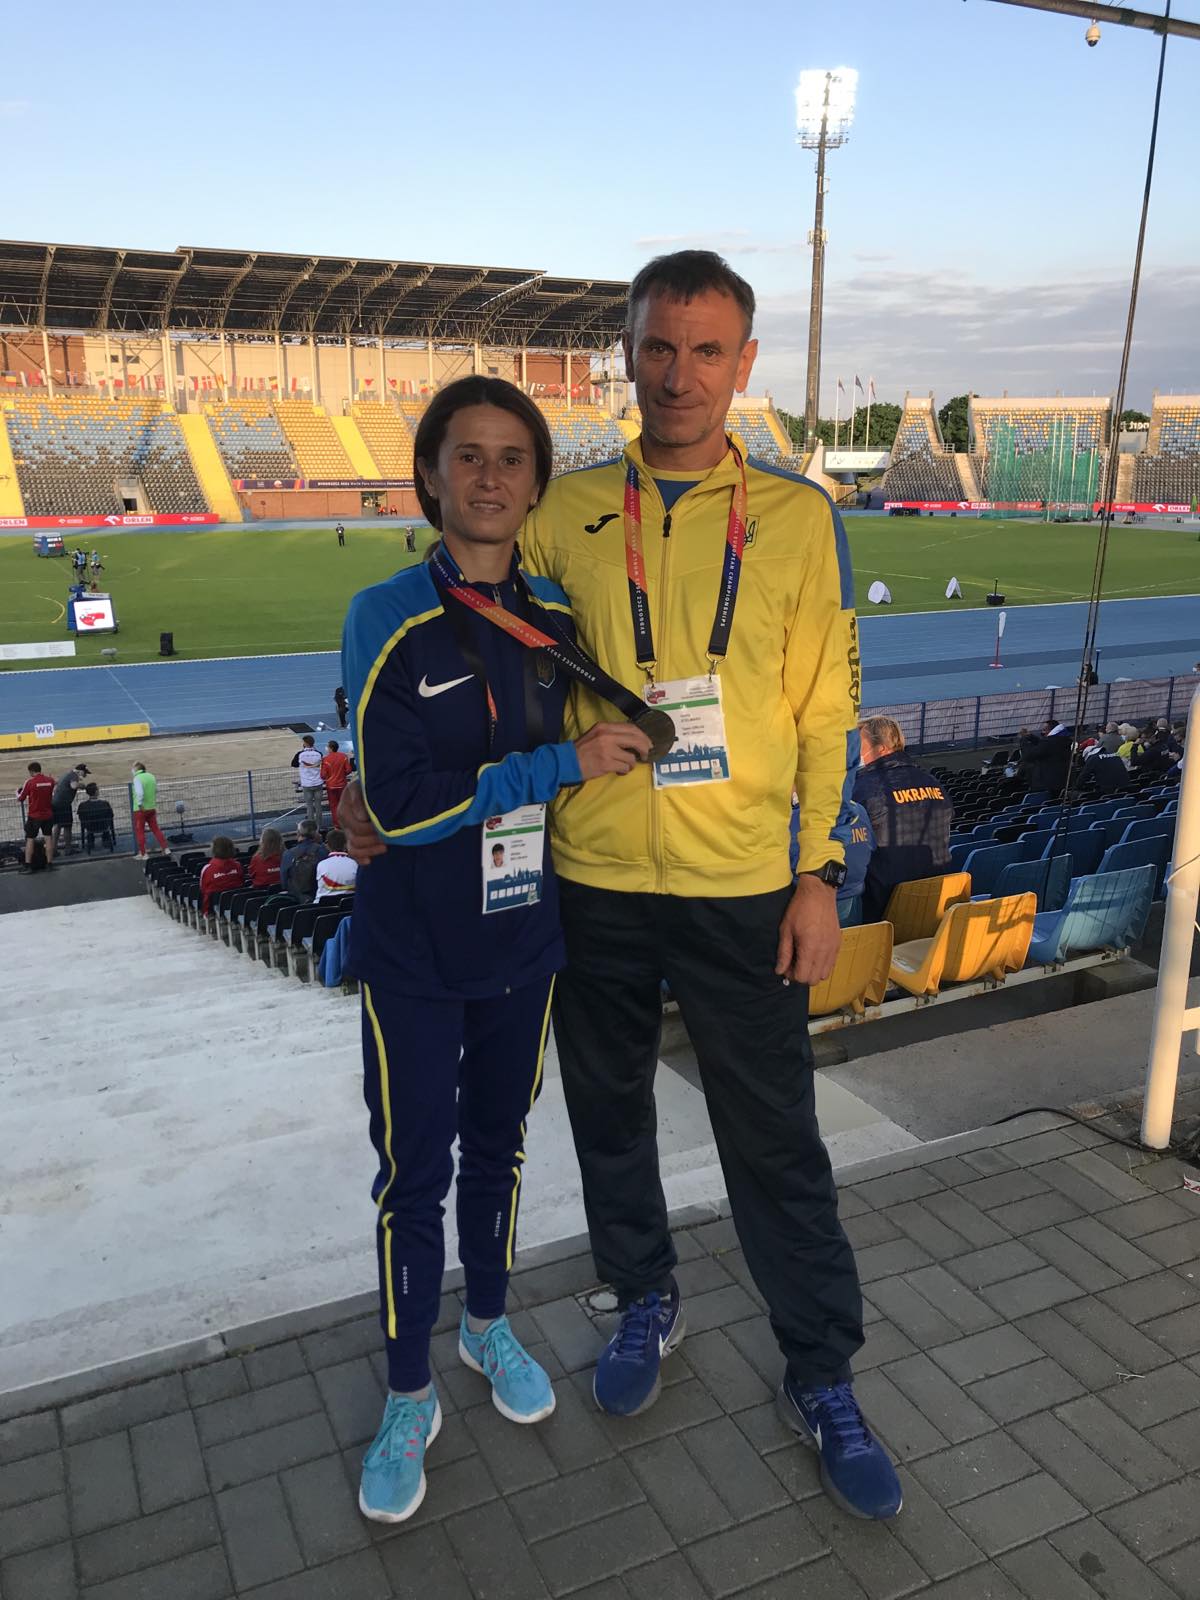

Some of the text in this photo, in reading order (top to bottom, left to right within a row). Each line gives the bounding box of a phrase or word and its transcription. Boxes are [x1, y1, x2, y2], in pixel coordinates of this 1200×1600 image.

[730, 535, 738, 569] EUROPEAN
[721, 572, 733, 627] CHAMPIONSHIPS
[35, 725, 53, 735] WR
[893, 786, 945, 804] UKRAINE
